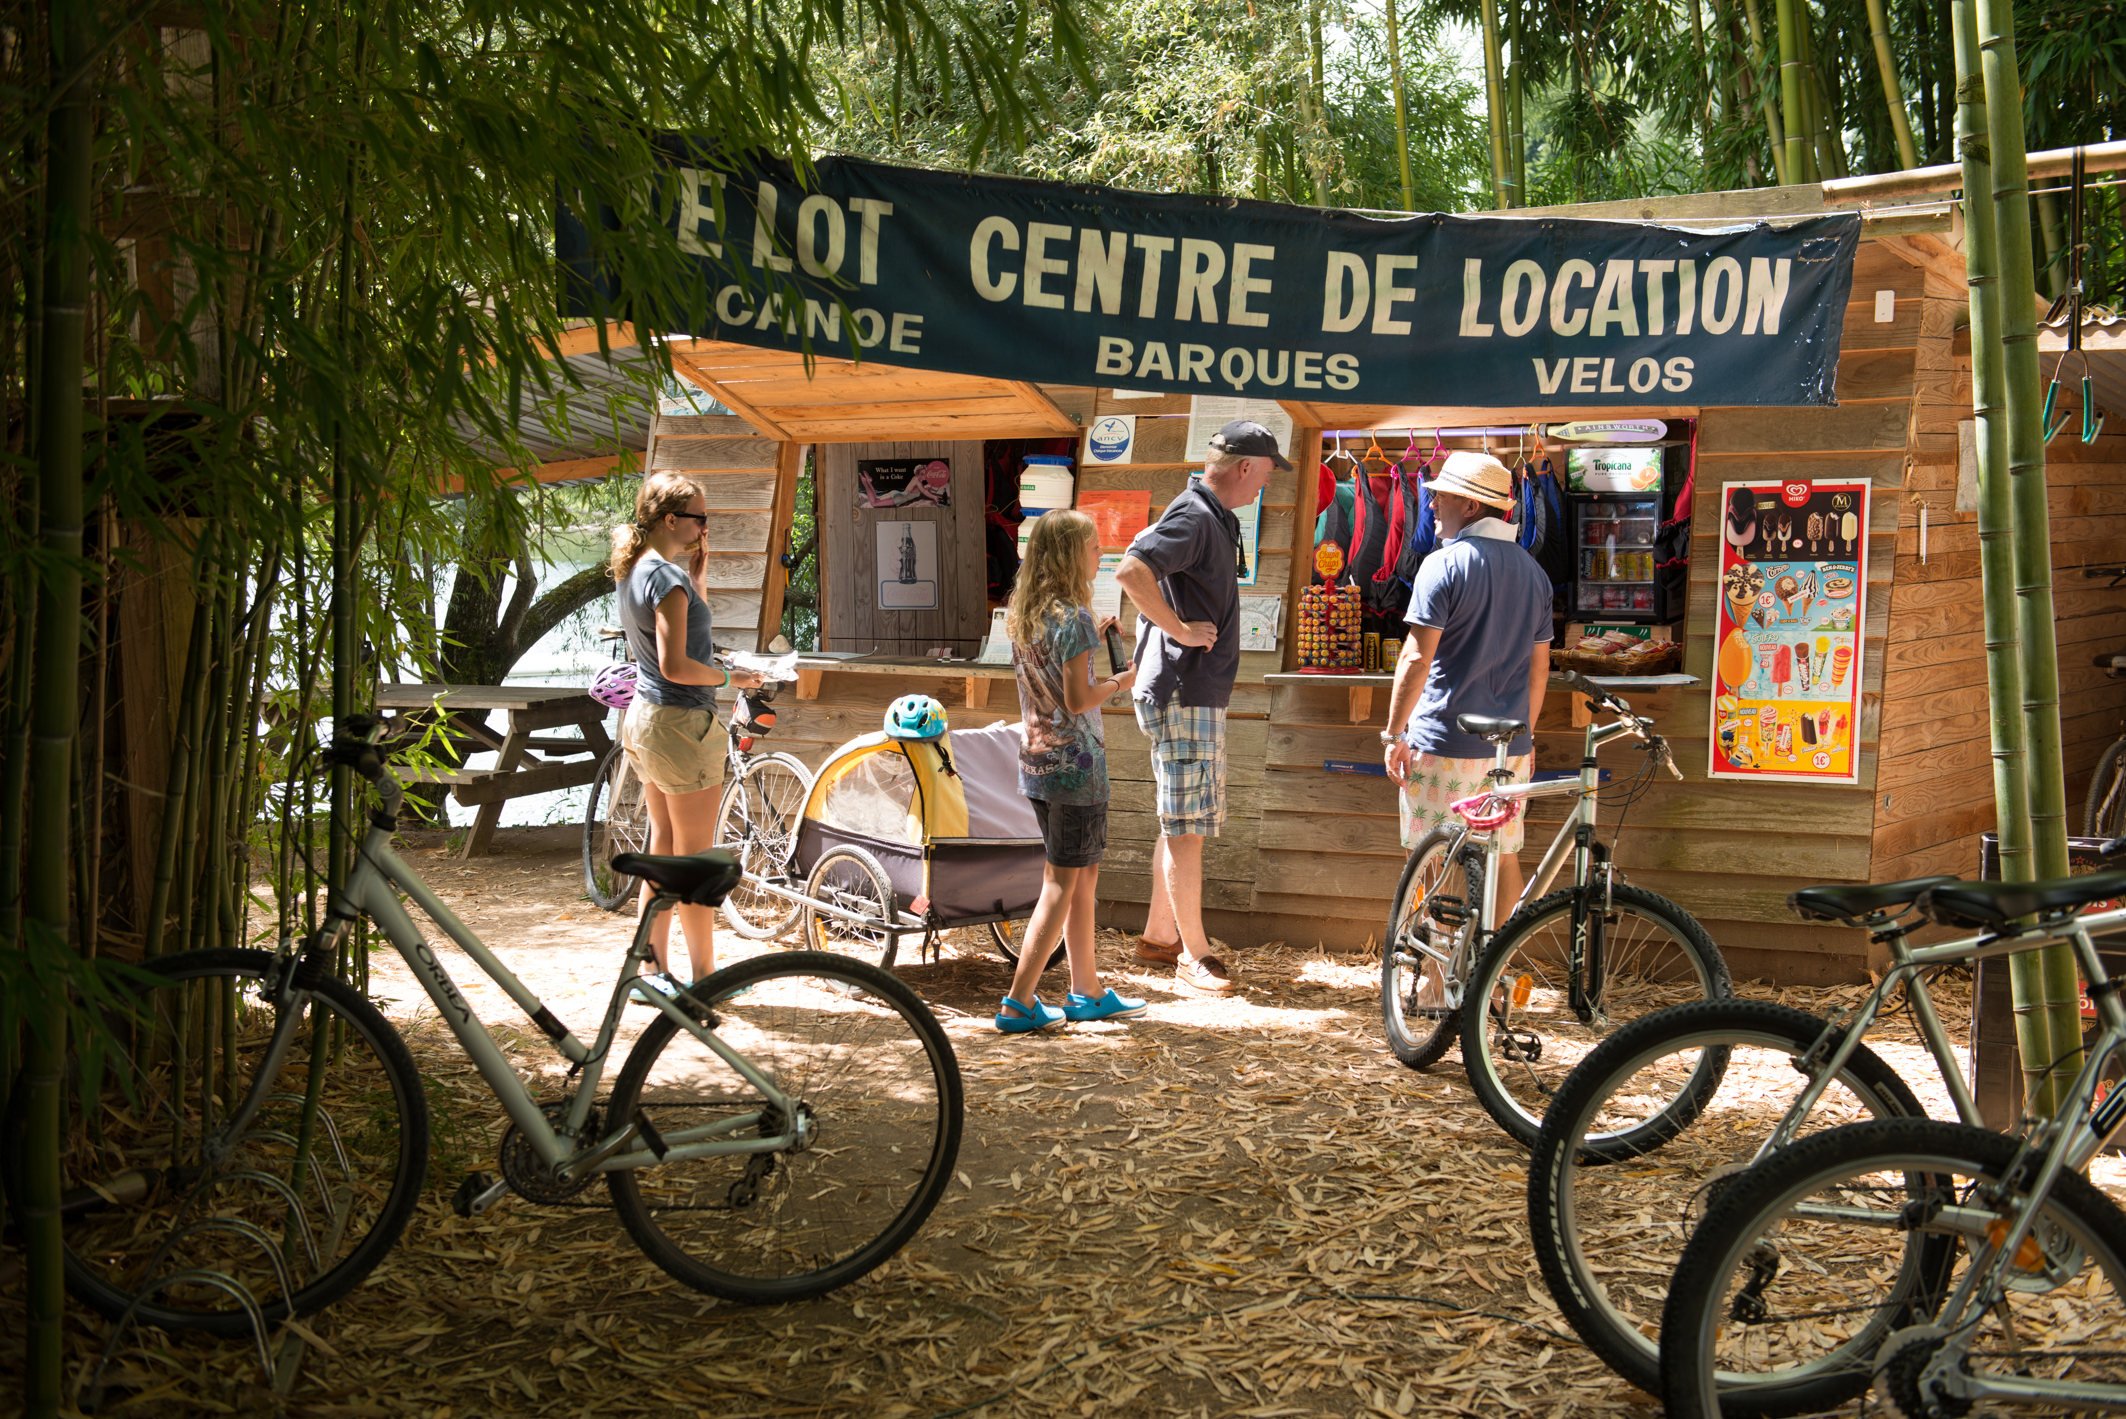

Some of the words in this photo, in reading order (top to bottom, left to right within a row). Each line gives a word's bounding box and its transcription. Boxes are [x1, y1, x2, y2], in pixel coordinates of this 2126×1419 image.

[752, 179, 894, 286] LOT
[970, 214, 1277, 329] CENTRE
[1321, 250, 1418, 337] DE
[1459, 255, 1792, 339] LOCATION
[715, 284, 924, 355] CANOE
[1095, 336, 1360, 391] BARQUES
[1532, 355, 1695, 395] VELOS
[1585, 423, 1649, 431] AINSWORTH
[1592, 459, 1632, 472] Tropicana
[1318, 551, 1340, 560] Chupa
[1318, 560, 1340, 569] Chups
[1751, 633, 1779, 645] SOLERO
[415, 943, 470, 1024] ORBEA
[1549, 1138, 1591, 1310] SPECIALIZED
